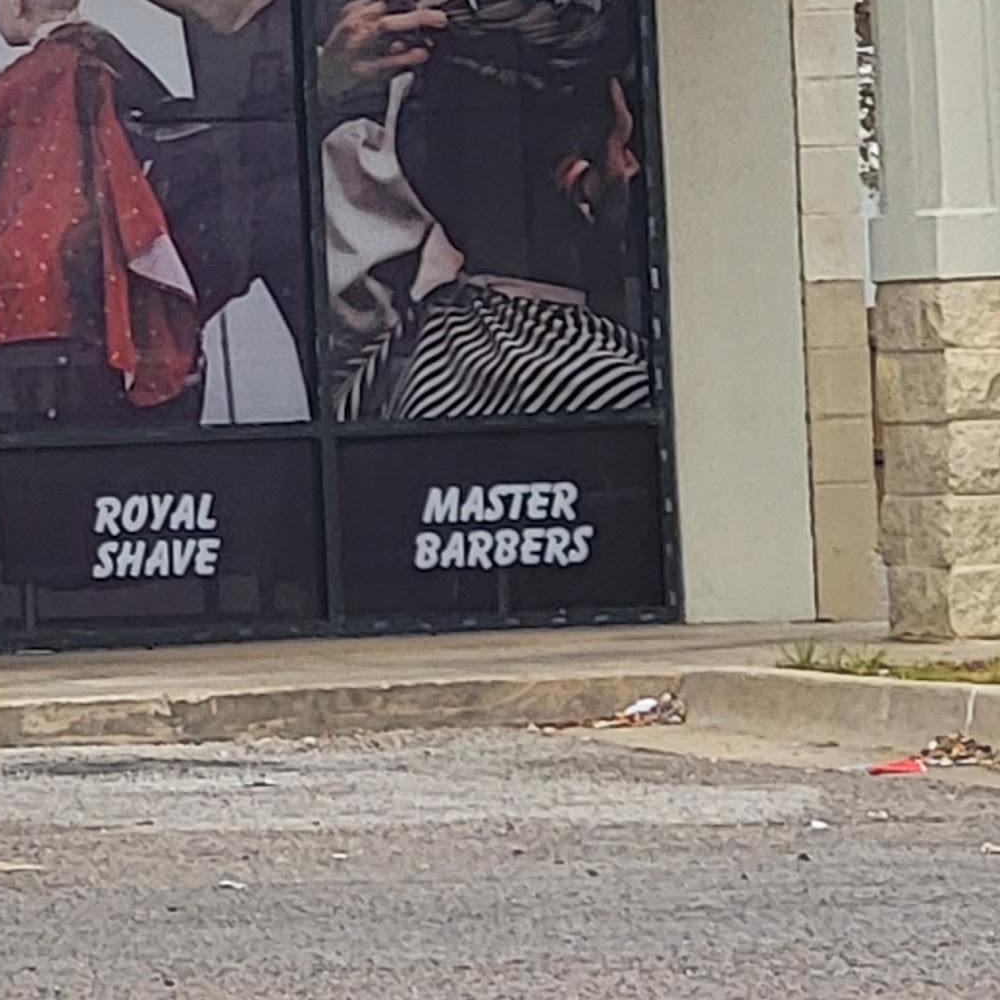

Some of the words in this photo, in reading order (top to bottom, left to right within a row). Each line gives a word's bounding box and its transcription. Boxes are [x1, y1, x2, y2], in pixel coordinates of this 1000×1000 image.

[94, 493, 218, 535] ROYAL
[421, 481, 578, 524] MASTER
[91, 537, 221, 579] SHAVE
[413, 525, 594, 570] BARBERS
